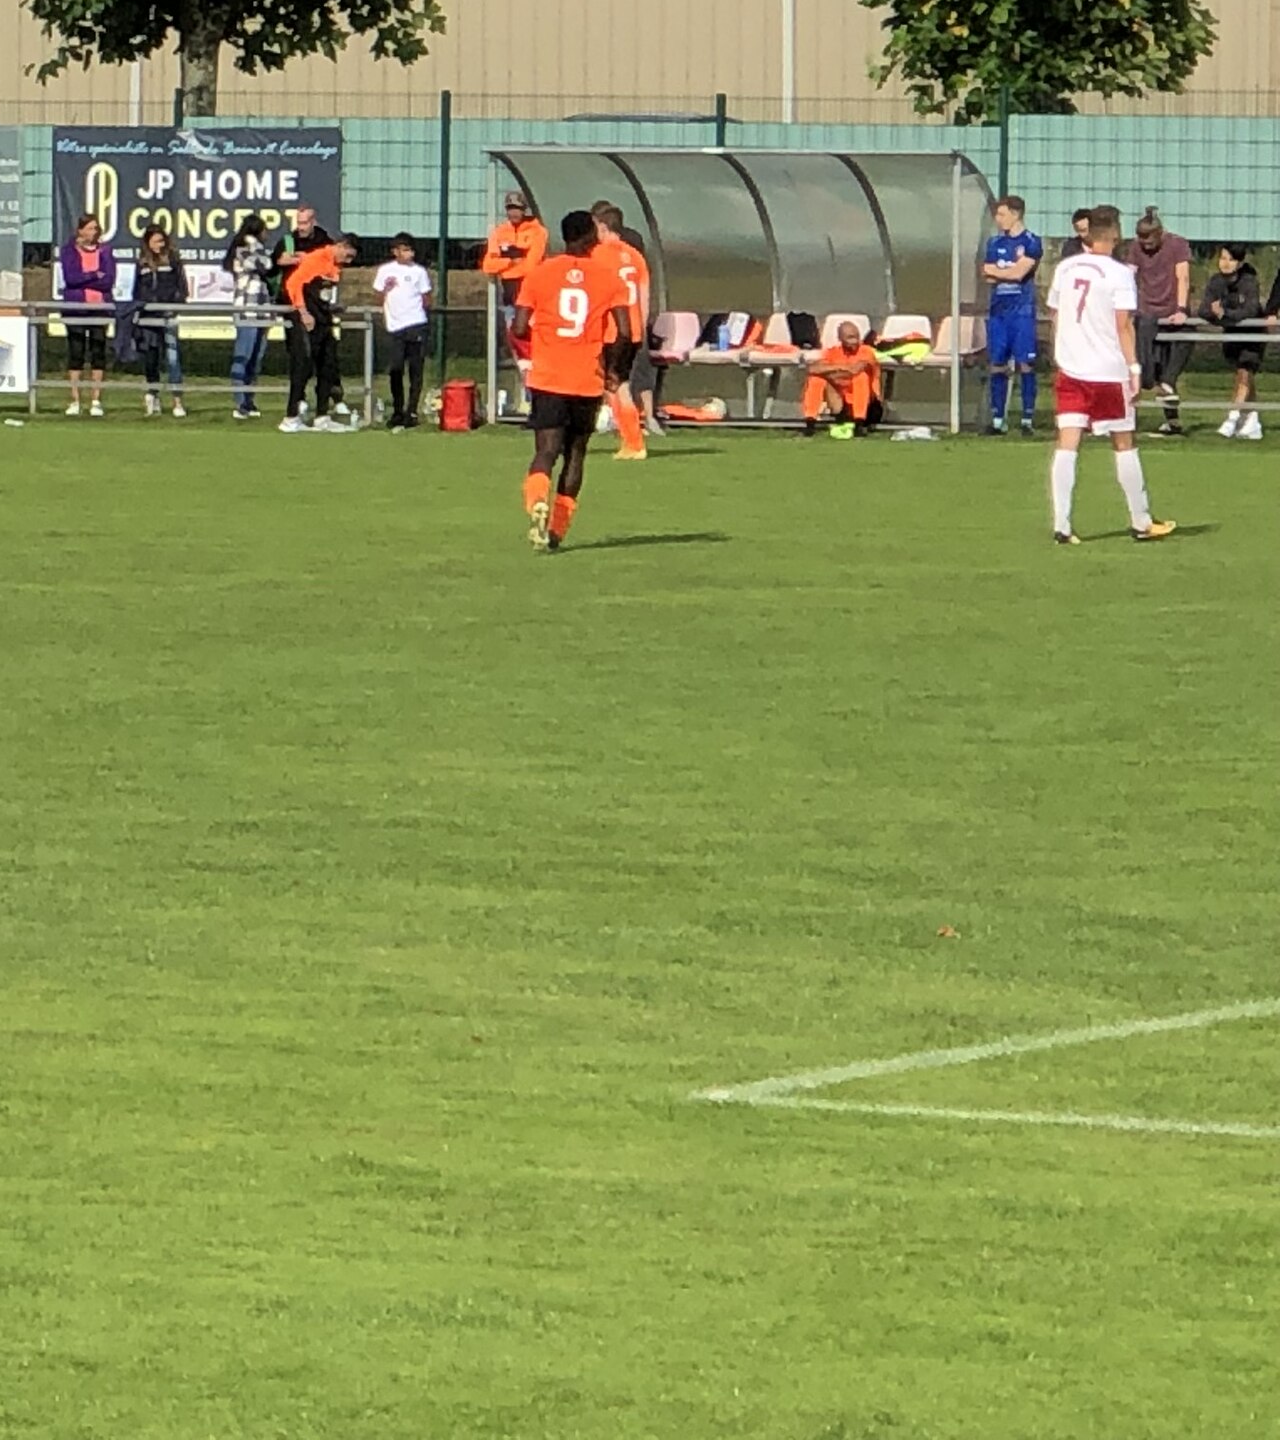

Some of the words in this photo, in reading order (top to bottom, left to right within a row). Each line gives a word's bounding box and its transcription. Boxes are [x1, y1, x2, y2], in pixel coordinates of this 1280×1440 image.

[137, 169, 174, 199] JP
[190, 169, 299, 200] HOME
[556, 287, 589, 338] 9
[1073, 278, 1091, 324] 7
